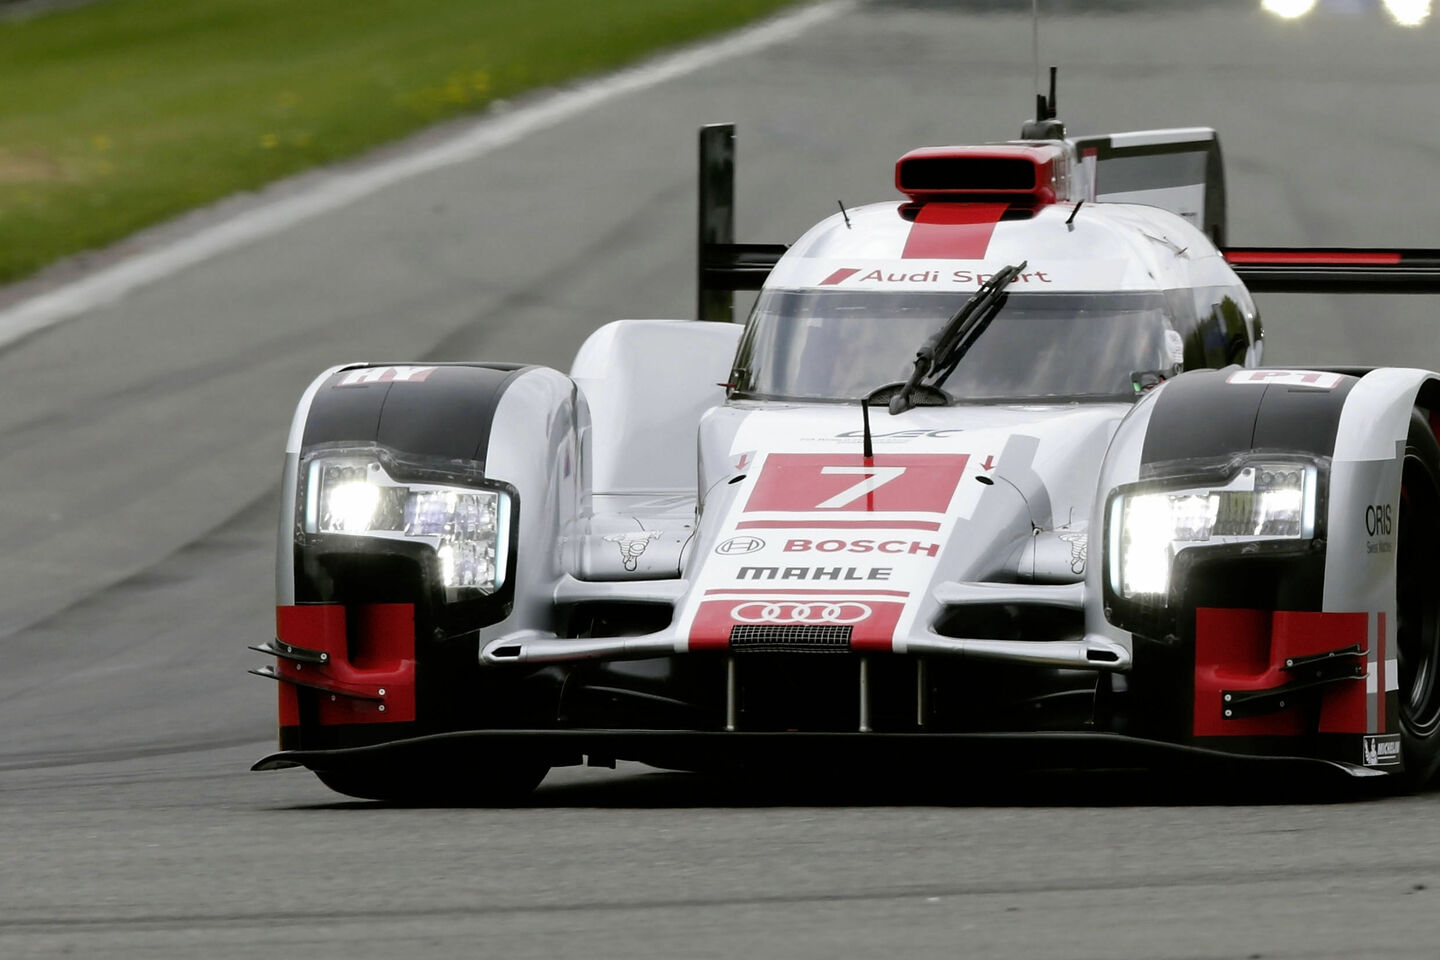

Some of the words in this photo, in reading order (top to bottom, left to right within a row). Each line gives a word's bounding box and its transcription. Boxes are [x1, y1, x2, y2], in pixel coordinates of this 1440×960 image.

[859, 270, 939, 283] Audi
[952, 270, 1052, 286] Sprt
[1248, 371, 1322, 383] P1
[815, 466, 907, 509] 7
[1365, 504, 1392, 537] ORIS
[782, 539, 941, 558] BOSCH
[735, 566, 893, 581] MAHLE
